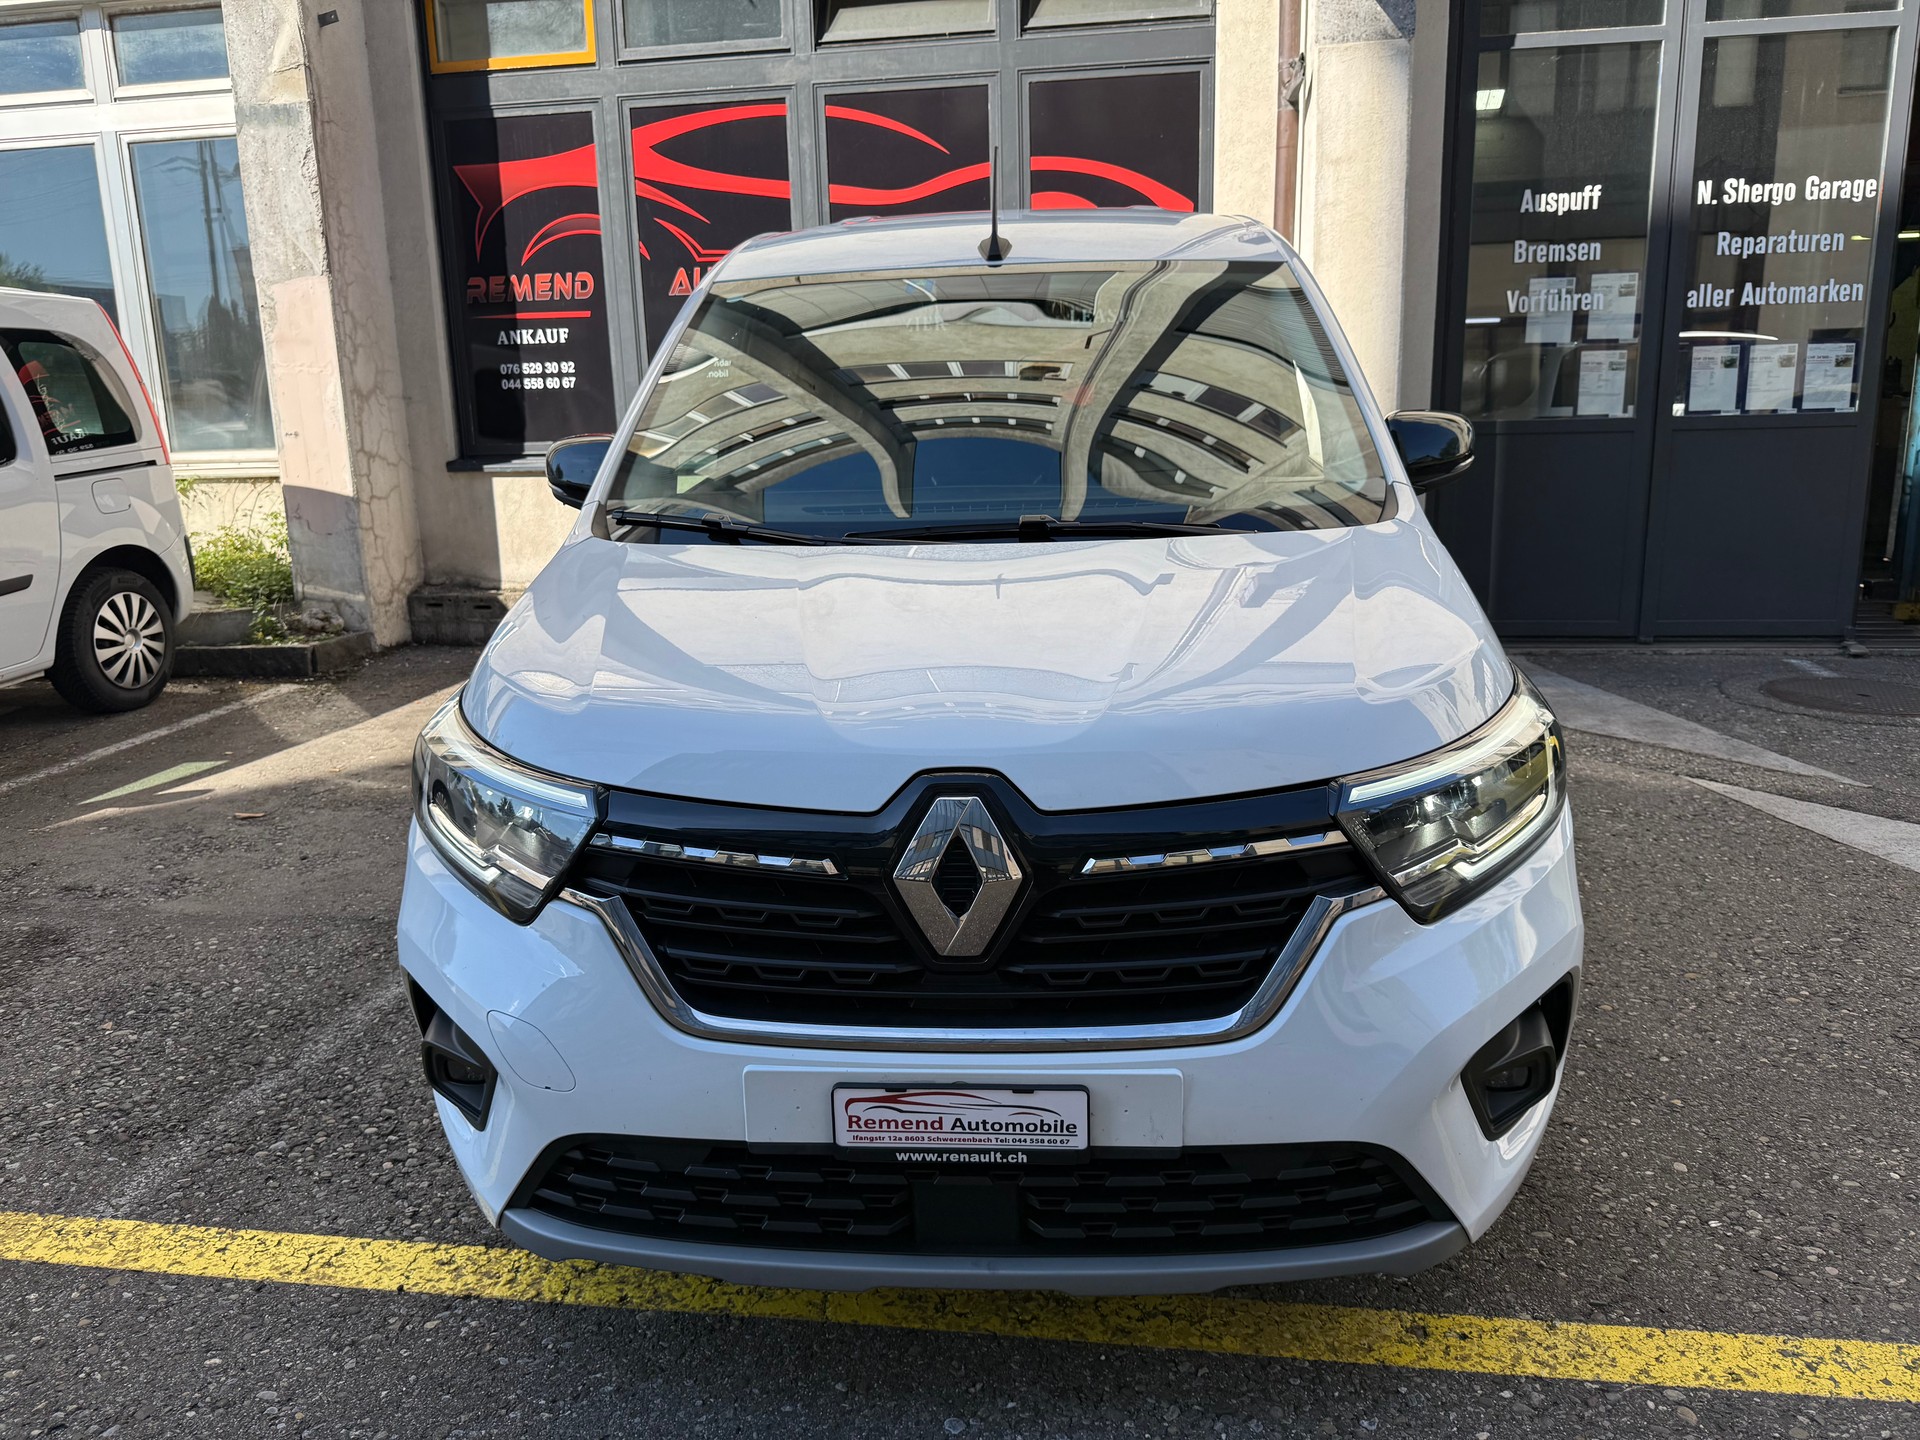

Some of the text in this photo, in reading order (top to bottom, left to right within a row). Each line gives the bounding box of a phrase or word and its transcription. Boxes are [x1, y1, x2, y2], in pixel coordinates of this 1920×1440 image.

[1520, 184, 1602, 216] Auspuff
[1697, 175, 1877, 206] N. Shergo Garage
[1514, 239, 1602, 264] Bremsen
[1716, 229, 1845, 259] Reparaturen
[466, 271, 595, 304] REMEND
[1686, 278, 1864, 308] aller Automarken
[1506, 287, 1604, 314] Vorführen
[497, 328, 570, 345] ANKAUF
[500, 361, 575, 375] 076 529 30 92
[501, 377, 576, 390] 044 558 60 67
[847, 1115, 1077, 1134] Remend Automobile
[927, 1135, 993, 1144] Schwerzenbach
[895, 1151, 1028, 1163] www.renault.ch
